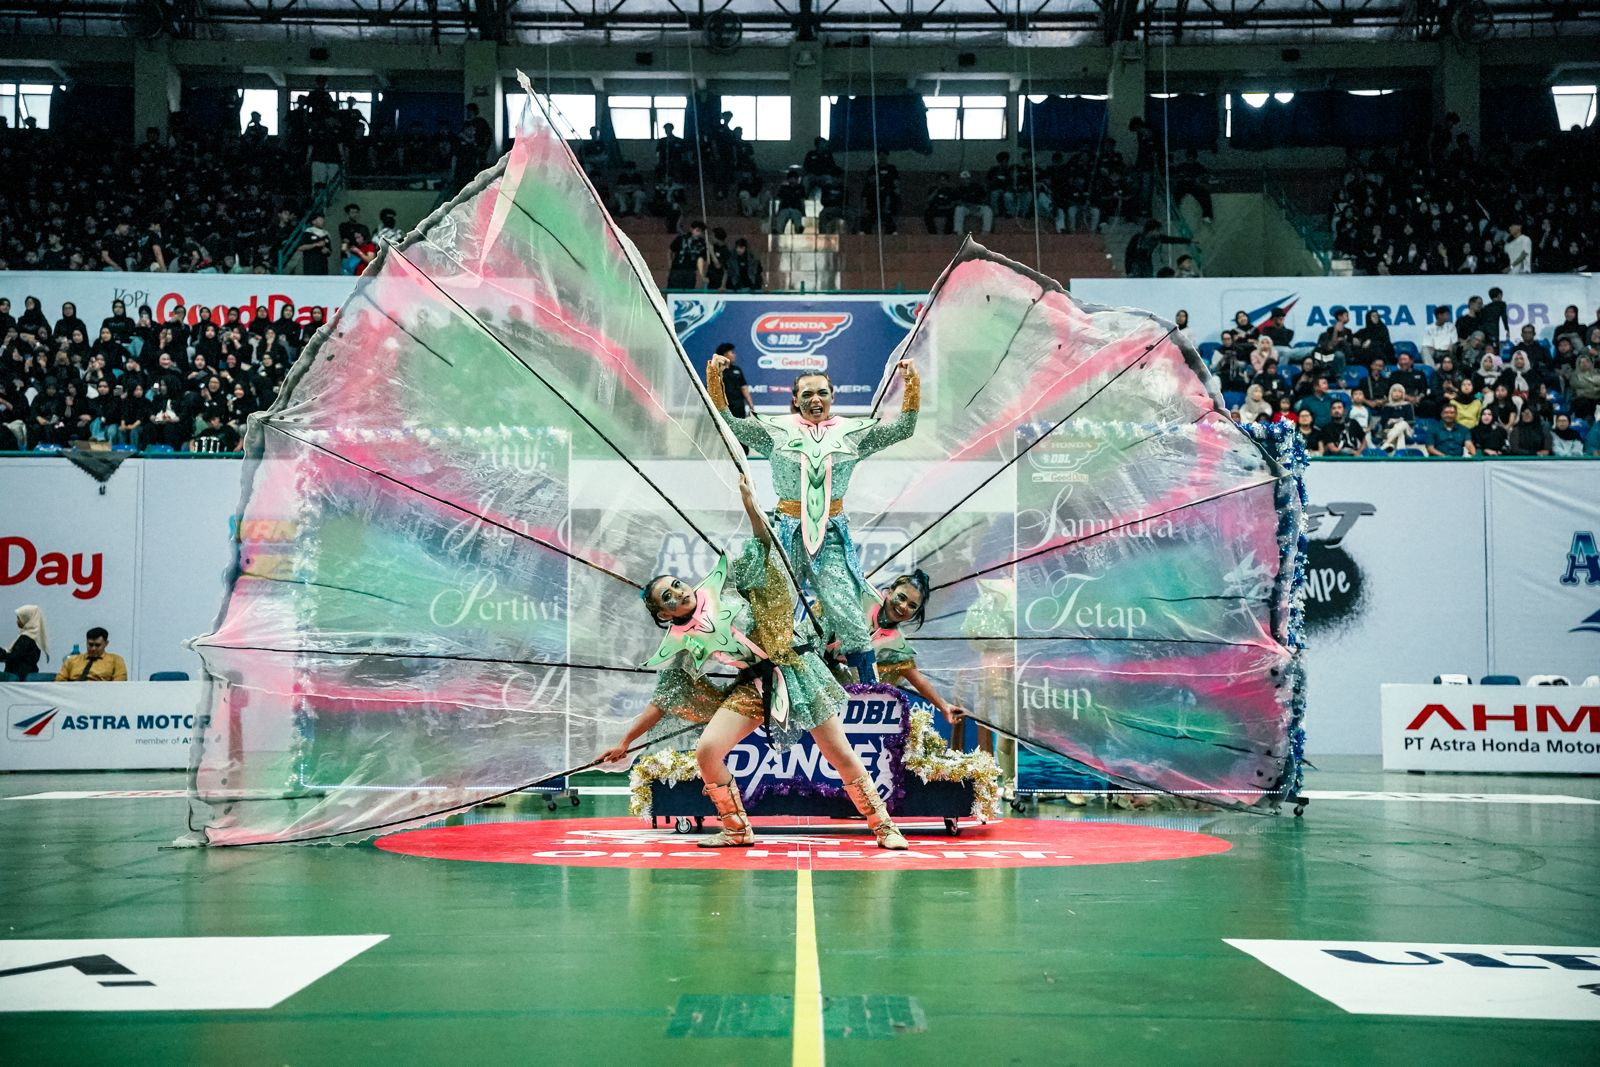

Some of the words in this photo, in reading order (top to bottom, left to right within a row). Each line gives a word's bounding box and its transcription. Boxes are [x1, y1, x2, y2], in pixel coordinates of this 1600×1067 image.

[780, 321, 828, 329] HONDA
[779, 334, 803, 345] DBL
[430, 563, 560, 628] Pertiwi
[1025, 569, 1147, 639] Tetap
[62, 715, 130, 730] ASTRA
[171, 736, 180, 745] of
[1404, 737, 1424, 750] PT
[1430, 738, 1475, 752] Astra
[1482, 738, 1540, 753] Honda
[1546, 739, 1600, 754] Motor
